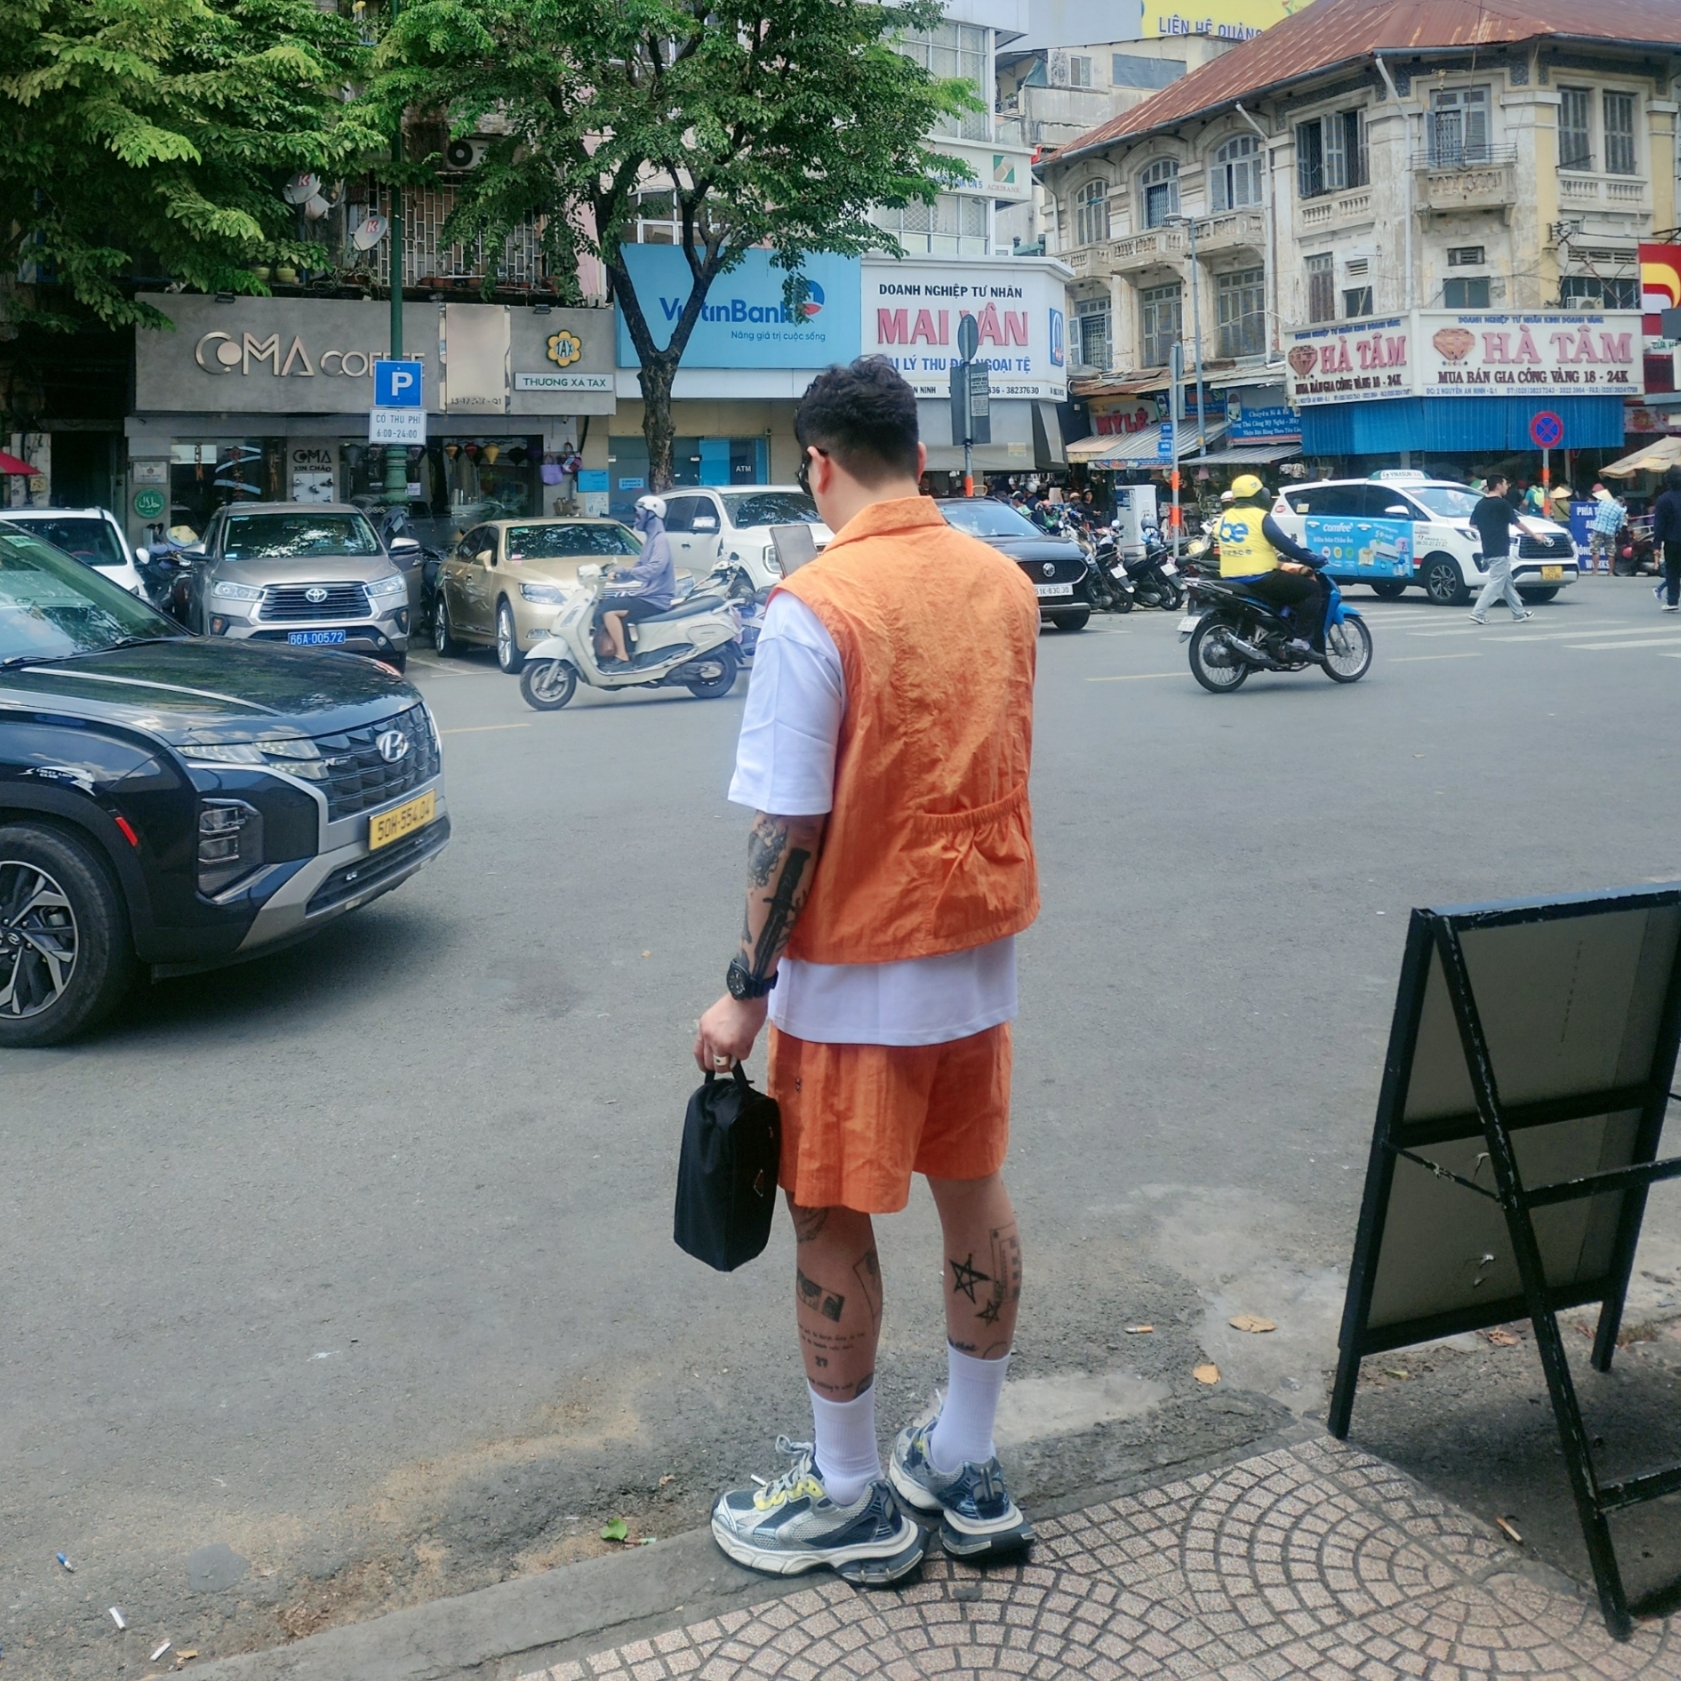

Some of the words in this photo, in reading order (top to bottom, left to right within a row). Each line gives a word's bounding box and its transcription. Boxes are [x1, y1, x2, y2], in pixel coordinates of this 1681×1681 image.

[1158, 14, 1190, 34] LIÊN
[879, 283, 921, 297] DOANH
[924, 283, 968, 300] NGHIỆP
[971, 285, 988, 298] TƯ
[990, 285, 1023, 299] NHÂN
[659, 297, 796, 324] VitinBank
[877, 308, 950, 345] MAI
[731, 330, 755, 341] Nâng
[756, 330, 771, 341] giá
[772, 331, 782, 342] trị
[783, 333, 804, 342] cuộc
[805, 331, 826, 343] sống
[1481, 324, 1543, 364] HÀ
[1549, 324, 1634, 364] TÂM
[195, 331, 315, 376] COMA
[556, 339, 573, 358] TAX
[1319, 335, 1353, 375] HÀ
[1356, 332, 1407, 371] TÂM
[903, 354, 917, 371] LÝ
[922, 358, 947, 371] THU
[1015, 356, 1031, 375] TỆ
[391, 371, 414, 397] P
[571, 377, 585, 387] XÁ
[587, 379, 607, 388] TAX
[1438, 371, 1464, 384] MUA
[1466, 367, 1491, 384] BÁN
[1494, 370, 1516, 384] GIA
[1517, 367, 1548, 384] CÔNG
[1550, 367, 1580, 384] VÀNG
[1584, 370, 1597, 383] 18
[1606, 370, 1630, 383] 24K
[920, 386, 937, 394] NINH
[1006, 386, 1040, 395] 38237630
[376, 412, 387, 424] CÓ
[390, 415, 405, 424] THU
[408, 414, 422, 425] PHÍ
[376, 429, 418, 439] 6:00-24:00
[292, 449, 332, 464] COMA
[309, 464, 332, 473] CHÀO
[735, 465, 752, 473] ATM
[1576, 505, 1593, 516] PHÍA
[1219, 516, 1249, 544] be
[290, 631, 343, 646] 66A-005.72
